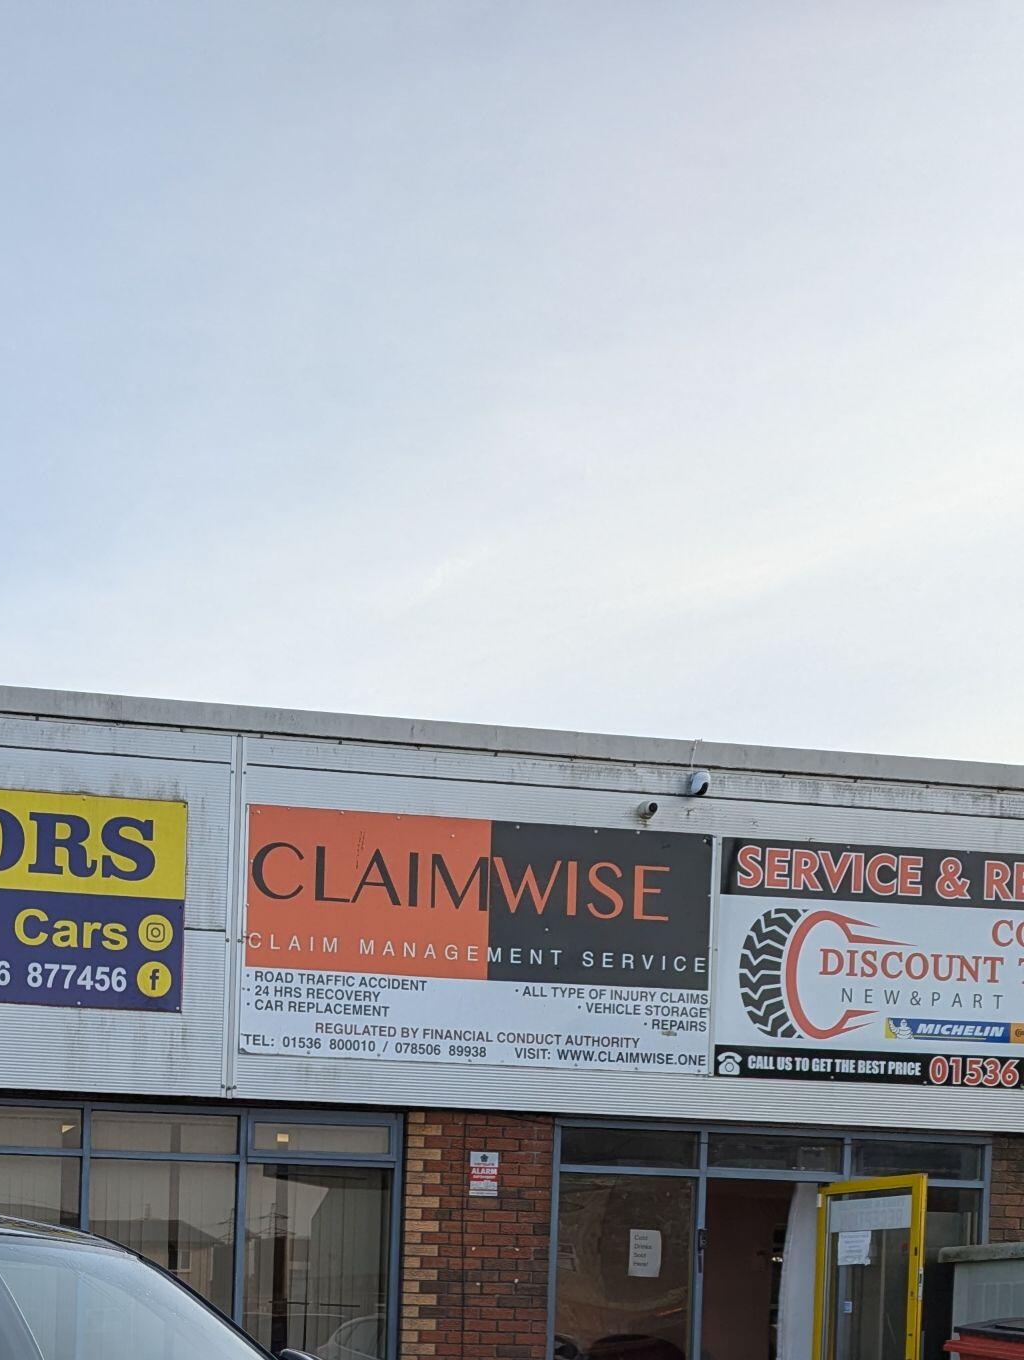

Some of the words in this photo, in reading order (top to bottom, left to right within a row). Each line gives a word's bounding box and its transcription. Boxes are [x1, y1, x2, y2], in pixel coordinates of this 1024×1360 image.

[251, 840, 671, 922] CLAIMWISE
[737, 845, 923, 896] SERVICE
[935, 856, 971, 899] &
[14, 908, 129, 951] Cars
[247, 931, 339, 954] CLAIM
[360, 936, 563, 966] MANAGEMENT
[582, 951, 707, 974] SERVICE
[27, 961, 127, 992] 877456
[819, 948, 1004, 984] DISCOUNT
[254, 971, 294, 984] ROAD
[298, 973, 356, 987] TRAFFIC
[359, 976, 427, 991] ACCIDENT
[254, 985, 270, 997] 24
[274, 986, 302, 999] HRS
[306, 989, 381, 1003] RECOVERY
[523, 986, 547, 997] ALL
[551, 987, 585, 999] TYPE
[588, 988, 606, 1000] OF
[610, 990, 656, 1002] INJURY
[660, 992, 708, 1005] CLAIMS
[254, 999, 283, 1012] CAR
[287, 1001, 390, 1017] REPLACEMENT
[585, 1002, 640, 1016] VEHICLE
[644, 1005, 707, 1018] STORAGE
[315, 1022, 397, 1038] REGULATED
[400, 1027, 419, 1039] BY
[422, 1028, 493, 1043] FINANCIAL
[496, 1032, 562, 1046] CONDUCT
[565, 1035, 640, 1048] AUTHORITY
[651, 1019, 707, 1032] REPAIRS
[916, 1022, 1004, 1038] MICHELIN
[242, 1033, 274, 1047] TEL:
[282, 1036, 321, 1050] 01536
[329, 1038, 376, 1052] 800010
[382, 1041, 388, 1053] /
[394, 1042, 441, 1056] 078506
[448, 1044, 486, 1057] 89938
[514, 1047, 551, 1060] VISIT:
[557, 1049, 706, 1066] WWW.CLAIMWISE.ONE
[748, 1055, 774, 1070] CALL
[776, 1057, 793, 1071] US
[795, 1058, 809, 1071] TO
[812, 1059, 833, 1073] GET
[834, 1060, 856, 1073] THE
[857, 1061, 886, 1075] BEST
[888, 1062, 921, 1076] PRICE
[929, 1056, 1019, 1086] 01536
